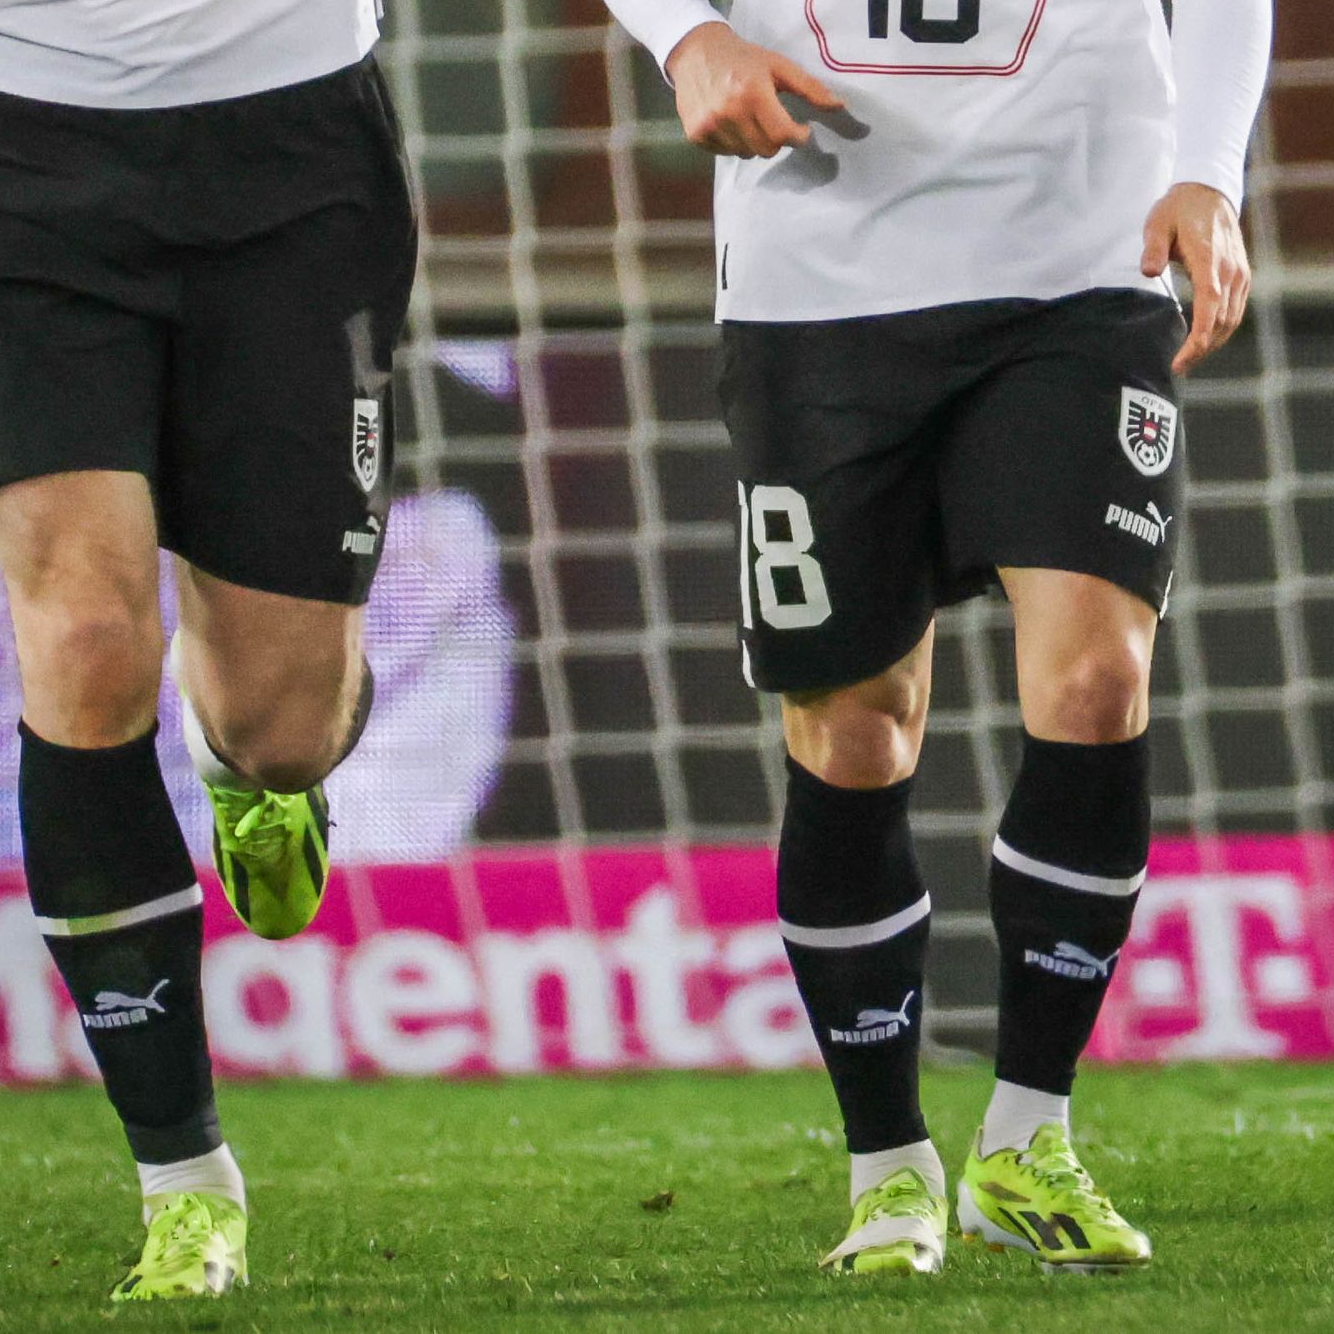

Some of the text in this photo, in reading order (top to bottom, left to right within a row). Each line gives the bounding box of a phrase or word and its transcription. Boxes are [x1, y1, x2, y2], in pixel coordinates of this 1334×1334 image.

[1104, 503, 1160, 546] PUMA
[1025, 949, 1097, 979] PUMA
[1130, 872, 1317, 1058] T
[830, 1020, 899, 1044] PUMA
